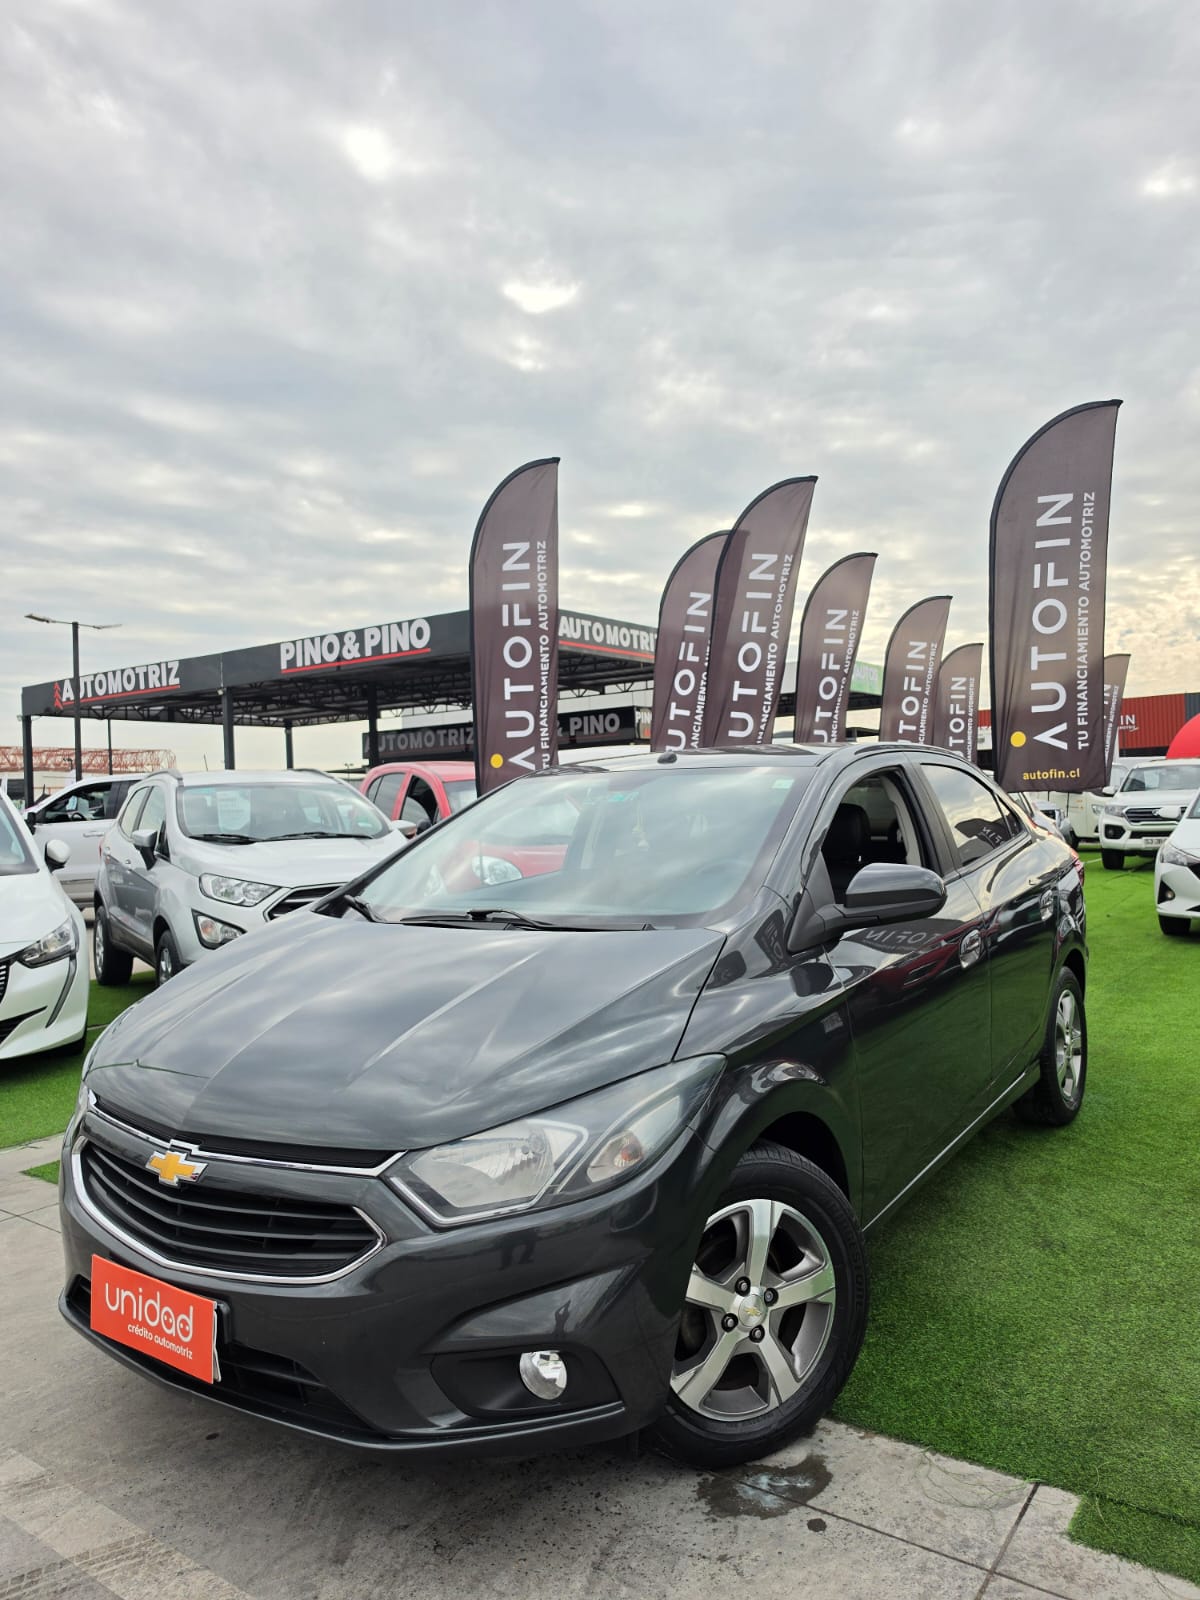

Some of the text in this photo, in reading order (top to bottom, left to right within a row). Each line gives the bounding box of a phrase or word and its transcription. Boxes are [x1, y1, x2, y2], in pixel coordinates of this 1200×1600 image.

[502, 541, 536, 771] AUTOFIN
[537, 540, 551, 769] TU FINANCIAMIENTO AUTOMOTRIZ
[558, 615, 658, 652] AUTOMOTRI
[666, 592, 712, 751] UTOFIN
[728, 553, 778, 738] UTOFIN
[756, 554, 793, 744] INANCIAMIENTO AUTOMOTRIZ
[1031, 492, 1074, 751] AUTOFIN
[1076, 491, 1096, 750] TU FINANCIAMIENTO AUTOMOTRIZ
[569, 713, 620, 736] PINO
[635, 711, 653, 724] PIN
[690, 672, 708, 749] ANCIAMIENTO
[813, 609, 848, 743] UTOFIN
[830, 609, 860, 743] ANCIAMIENTO AUTOMOTRIZ
[897, 641, 928, 743] TOFIN
[919, 697, 929, 744] CIAMIENTO
[949, 677, 967, 757] TOFIN
[1022, 768, 1080, 780] autofin.cl
[105, 1282, 194, 1343] unidad
[127, 1324, 193, 1360] crédito automotriz
